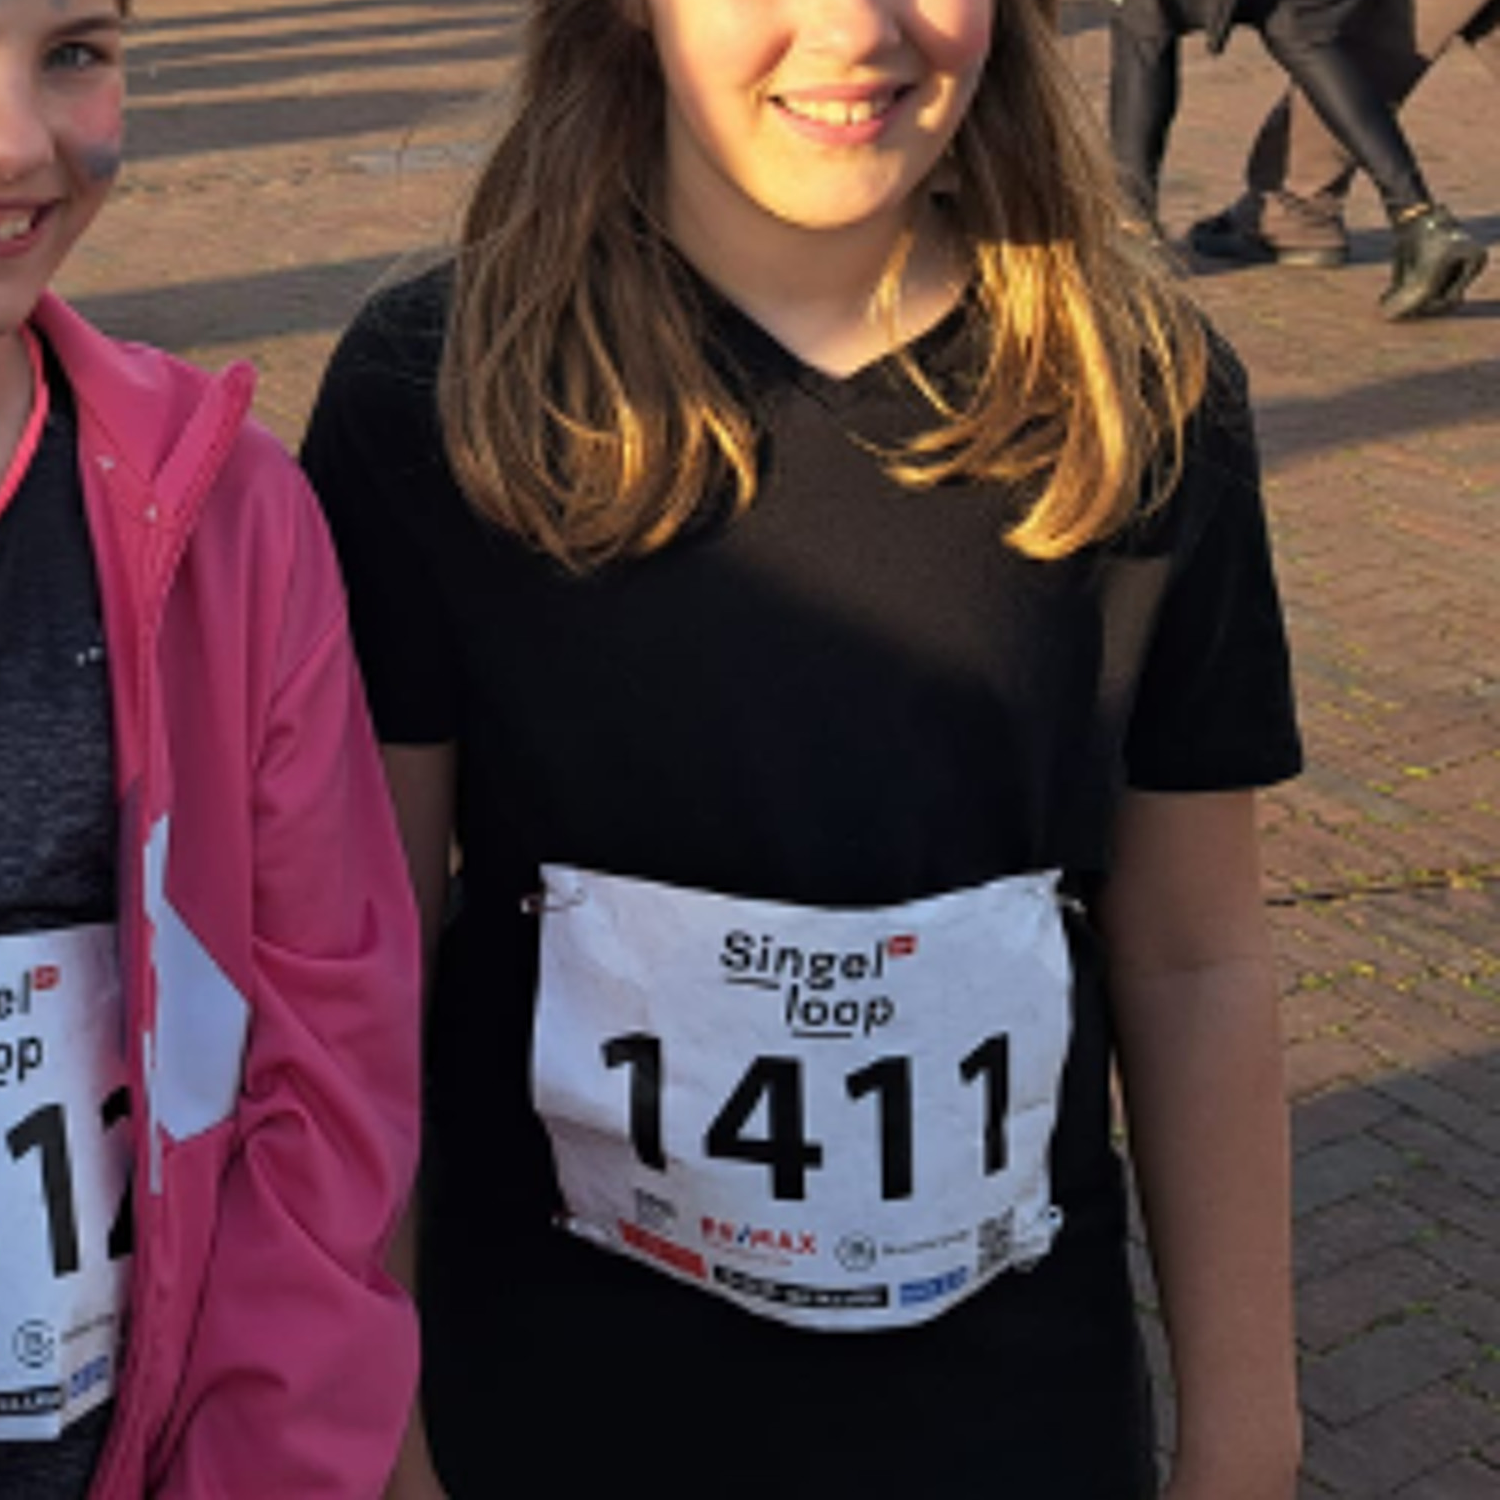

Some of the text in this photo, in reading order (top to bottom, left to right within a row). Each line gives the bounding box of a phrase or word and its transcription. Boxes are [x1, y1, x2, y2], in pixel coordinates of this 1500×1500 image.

[720, 930, 884, 990] Singel
[785, 983, 895, 1037] loop
[601, 1031, 1009, 1201] 1411
